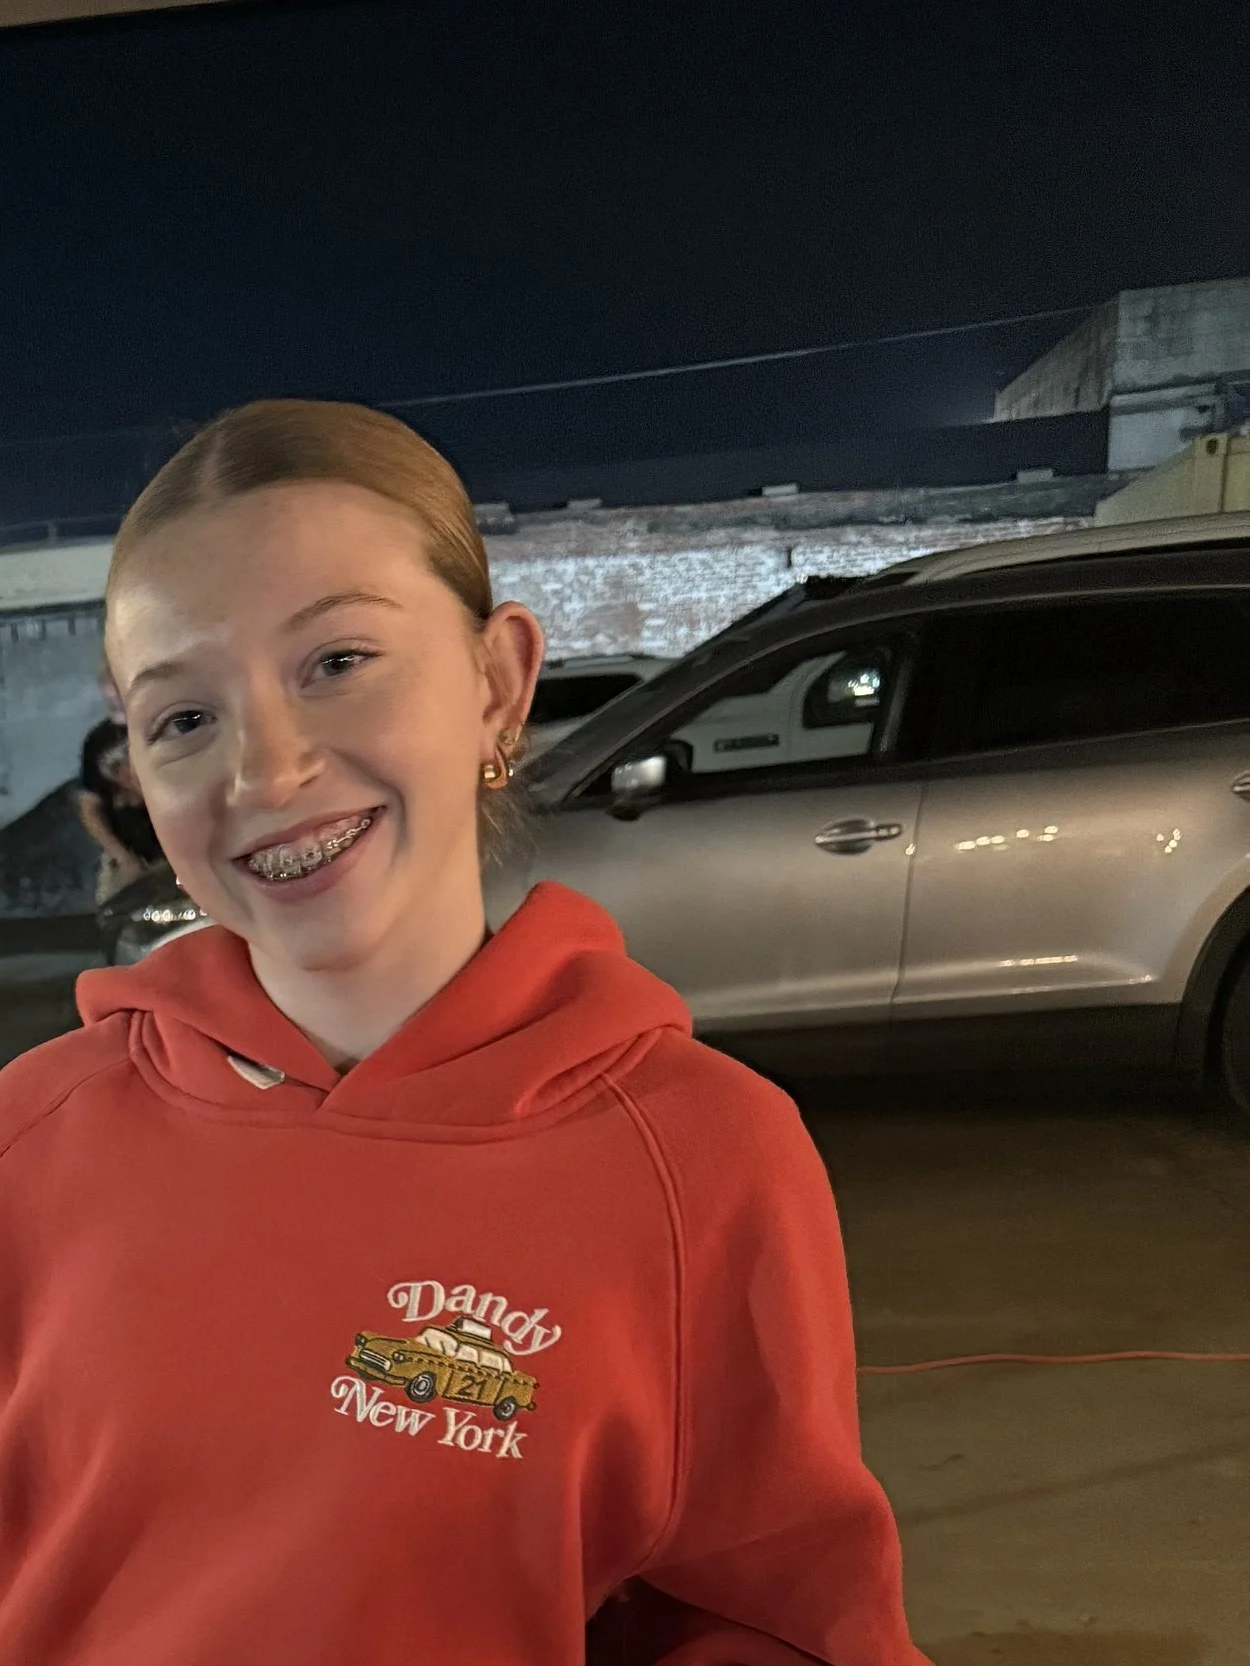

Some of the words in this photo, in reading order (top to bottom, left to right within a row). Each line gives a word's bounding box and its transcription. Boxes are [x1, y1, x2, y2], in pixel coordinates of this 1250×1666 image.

[387, 1280, 562, 1356] Dandy
[330, 1375, 437, 1436] New
[437, 1407, 528, 1459] York
[458, 1376, 487, 1400] 21
